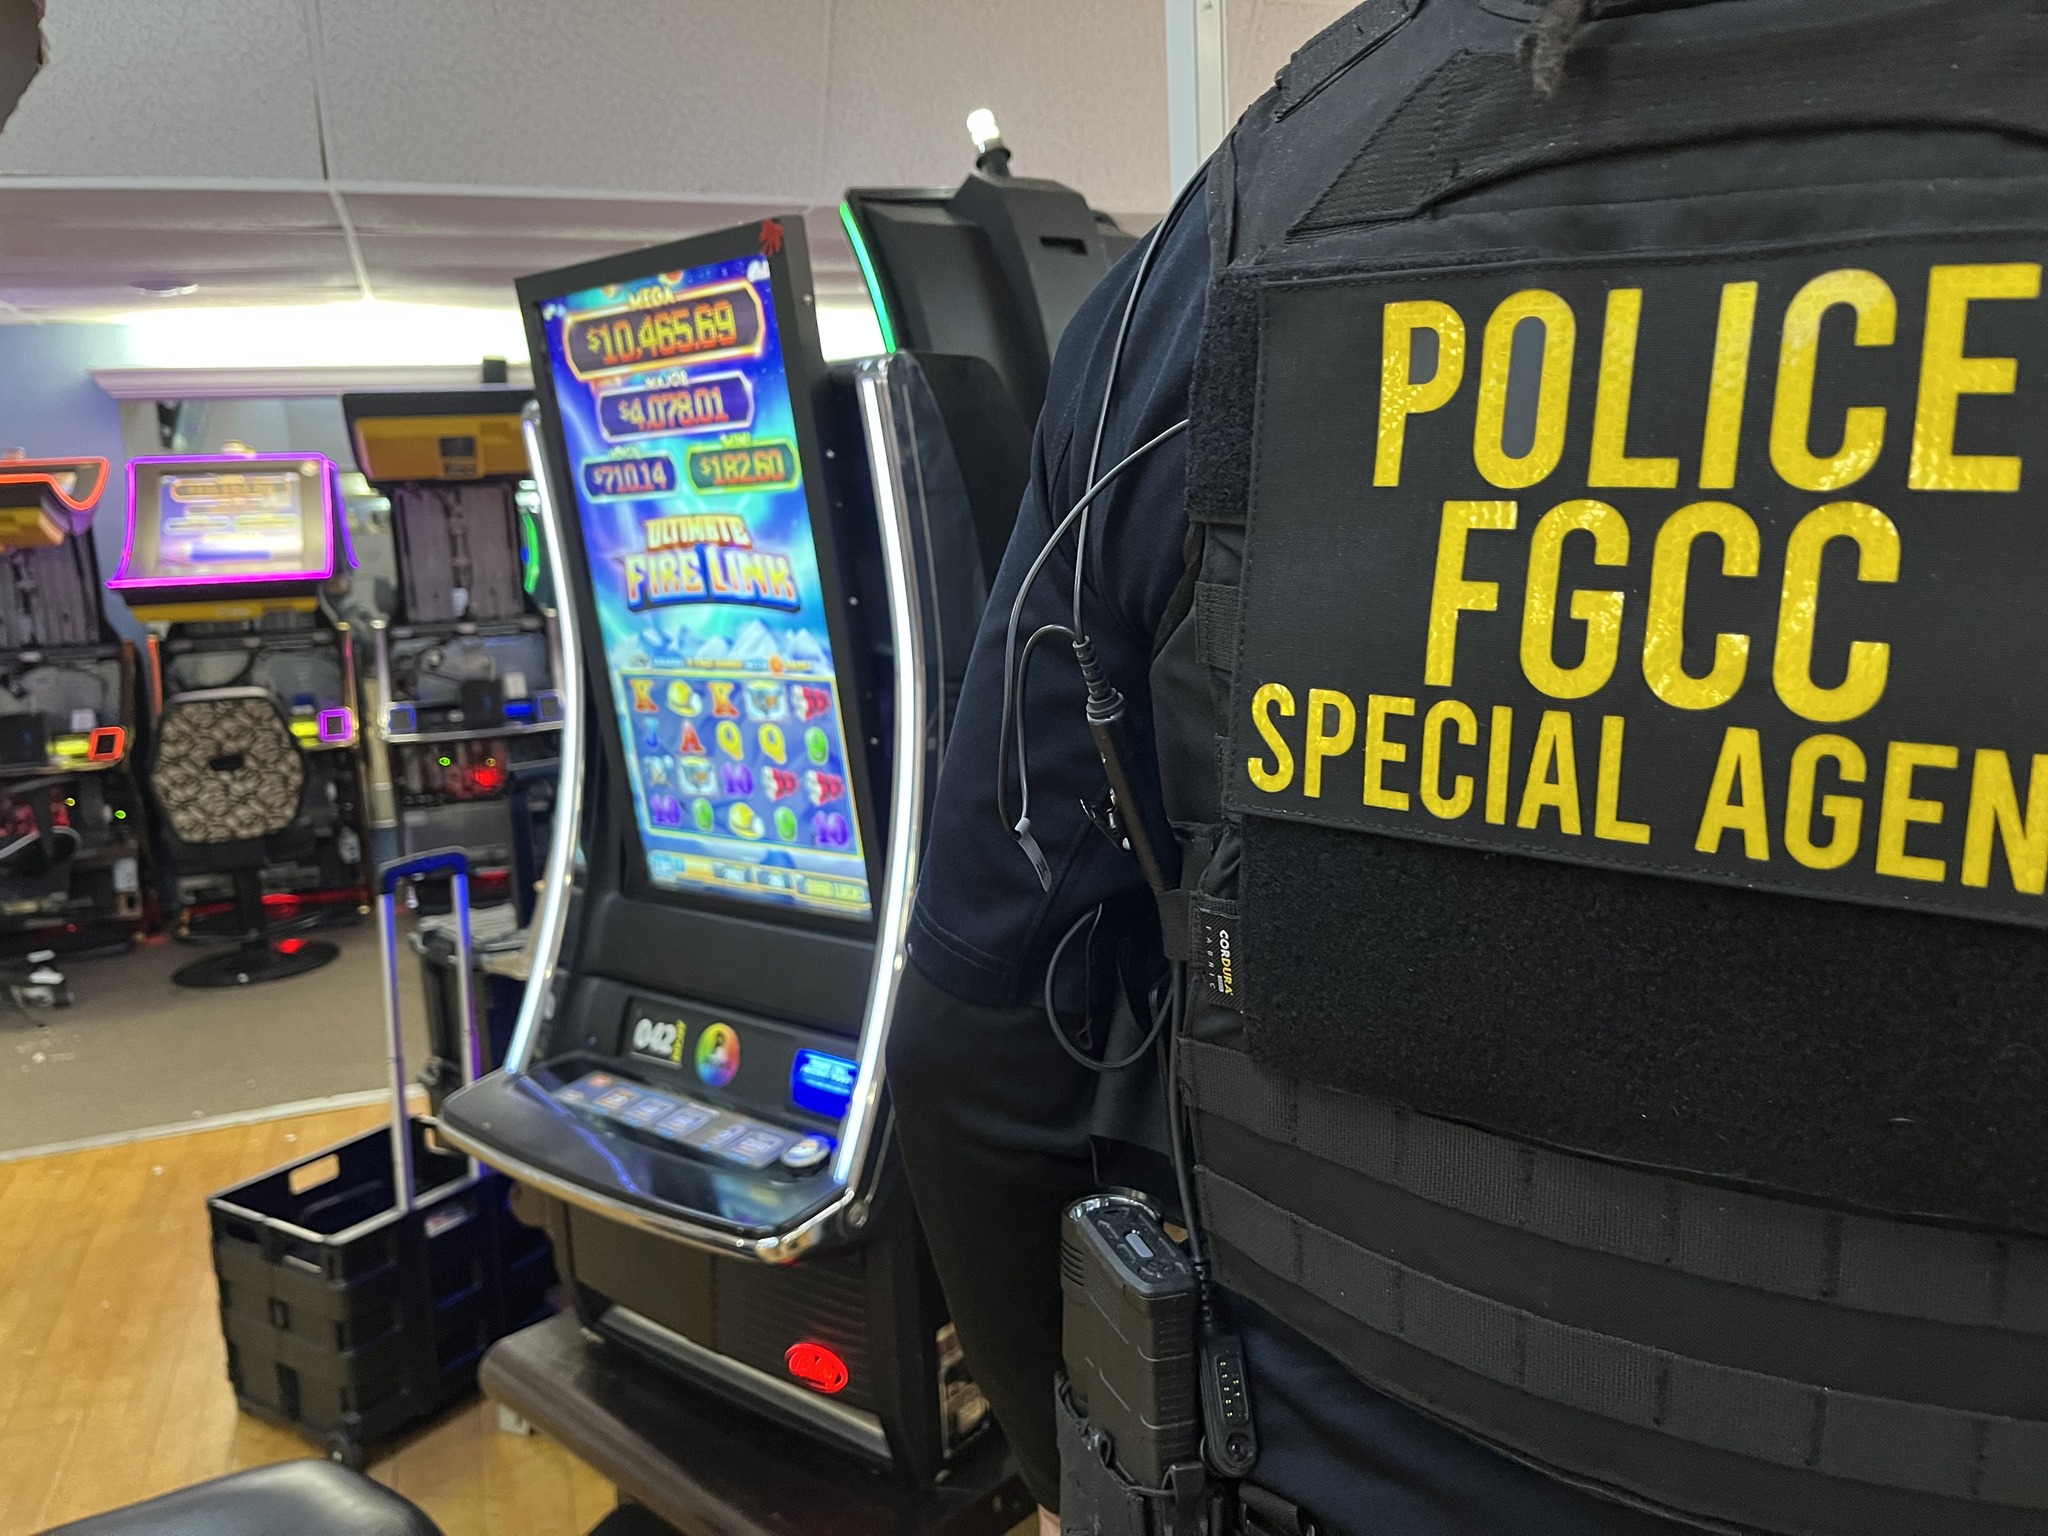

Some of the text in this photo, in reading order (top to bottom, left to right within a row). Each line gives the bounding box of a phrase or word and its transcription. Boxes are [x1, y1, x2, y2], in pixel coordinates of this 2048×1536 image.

[1372, 261, 2042, 493] POLICE
[701, 449, 785, 486] $182.60
[644, 514, 753, 553] ULTIMATE
[624, 544, 800, 605] FIRE LINK
[1423, 498, 1901, 724] FGCC
[1247, 683, 2048, 895] SPECIAL AGEN
[1219, 929, 1233, 994] CORDURA
